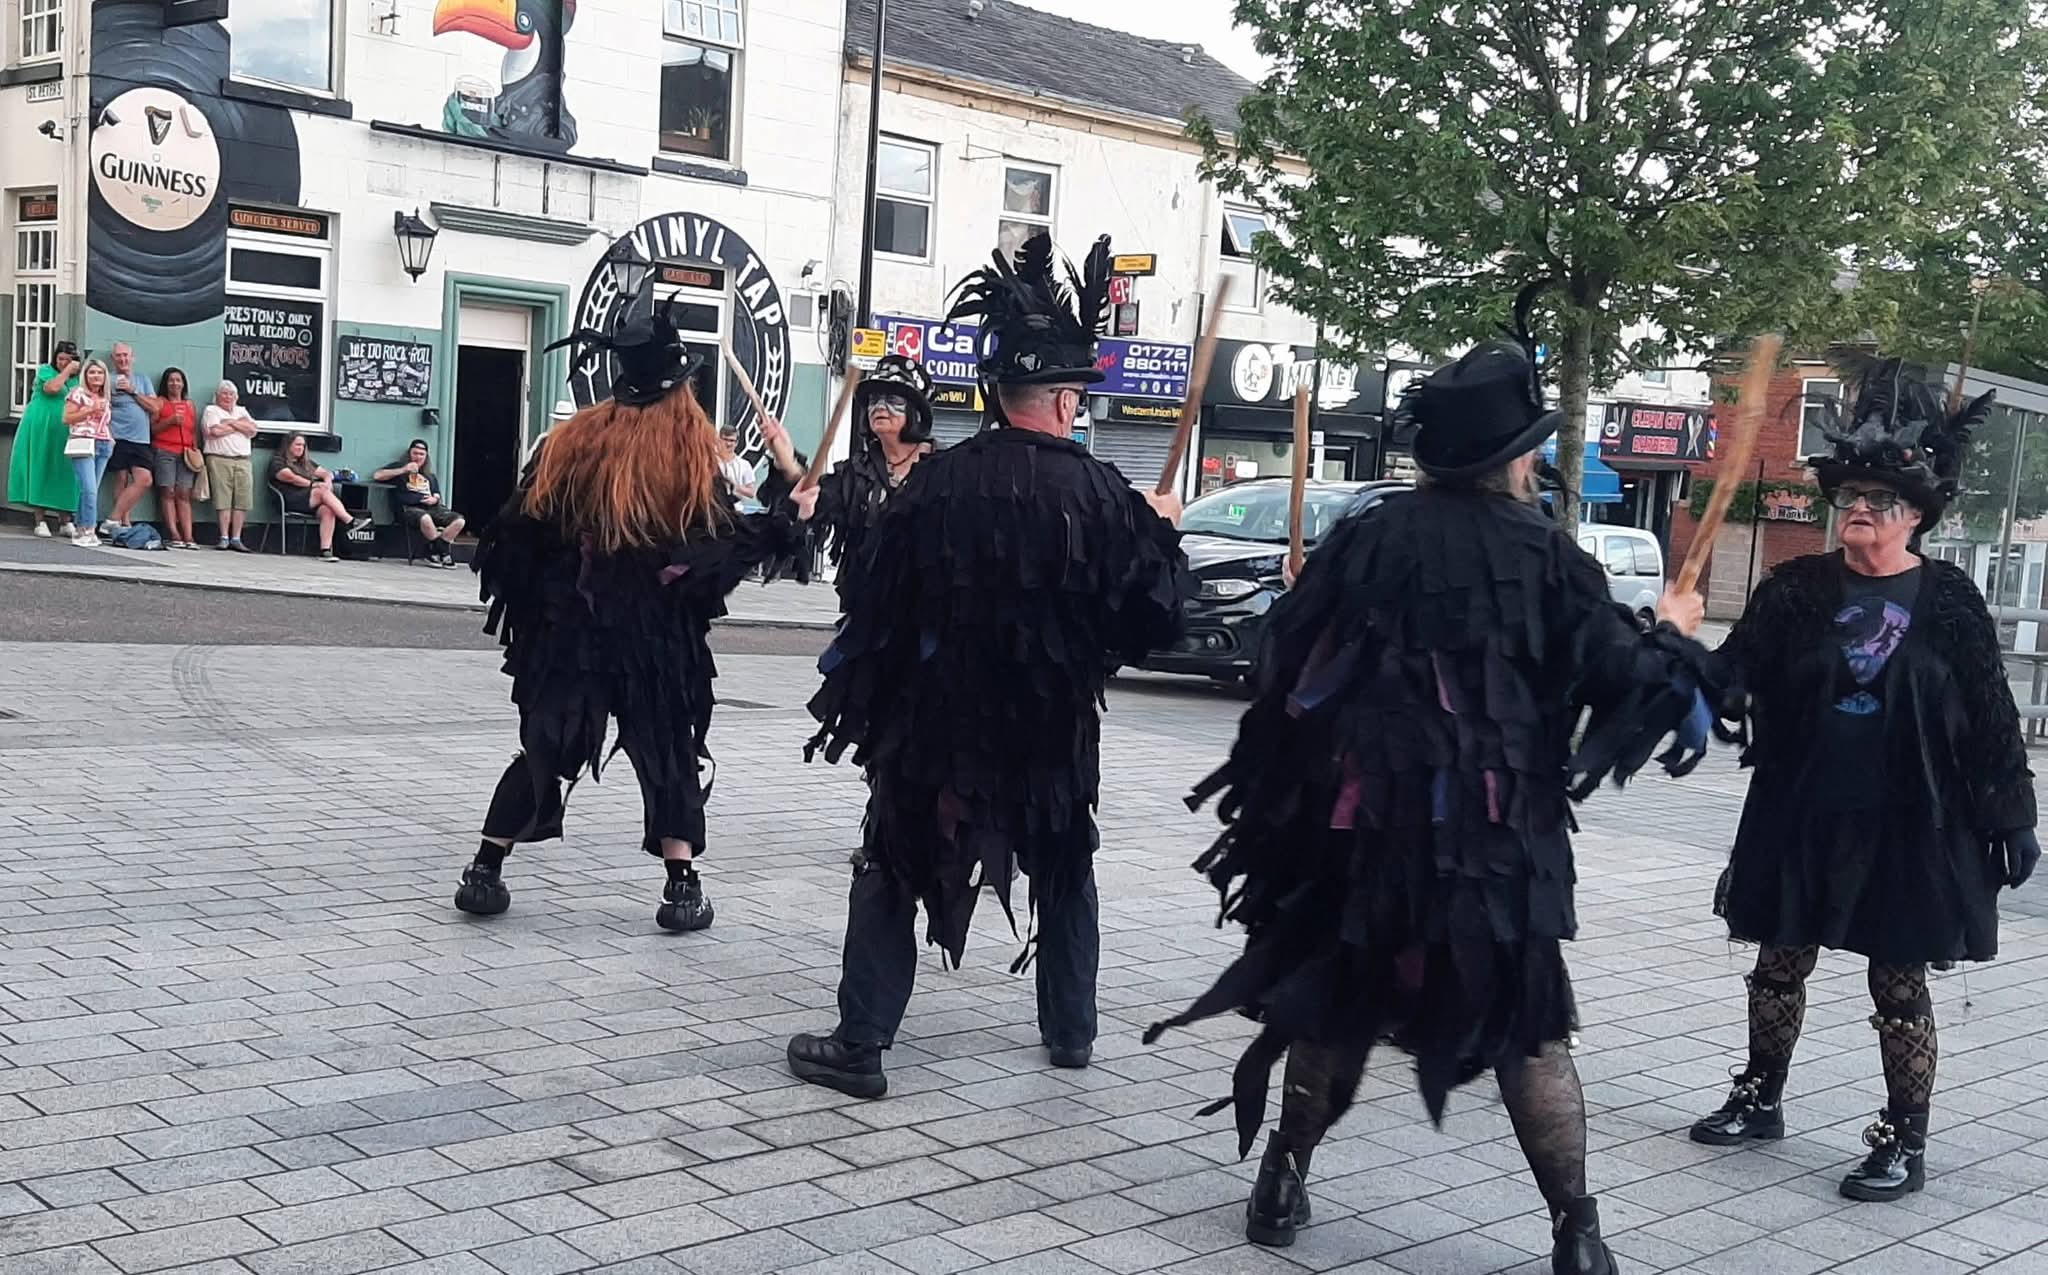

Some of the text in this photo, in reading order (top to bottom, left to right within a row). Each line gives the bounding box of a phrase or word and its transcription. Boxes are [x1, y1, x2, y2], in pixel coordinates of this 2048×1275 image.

[100, 152, 207, 198] GUINNESS
[280, 218, 318, 233] SERVED
[629, 215, 784, 326] VINYL TAP
[224, 306, 313, 327] PRESTON'S ONLY
[224, 323, 297, 340] VINYL RECORD
[229, 341, 265, 366] ROCK
[350, 342, 366, 358] WE
[367, 343, 381, 359] DO
[383, 344, 407, 361] ROCK
[1128, 344, 1188, 360] 01772
[1123, 357, 1188, 373] 880111
[245, 379, 287, 398] VENUE
[1631, 409, 1686, 431] CLEAN CUT
